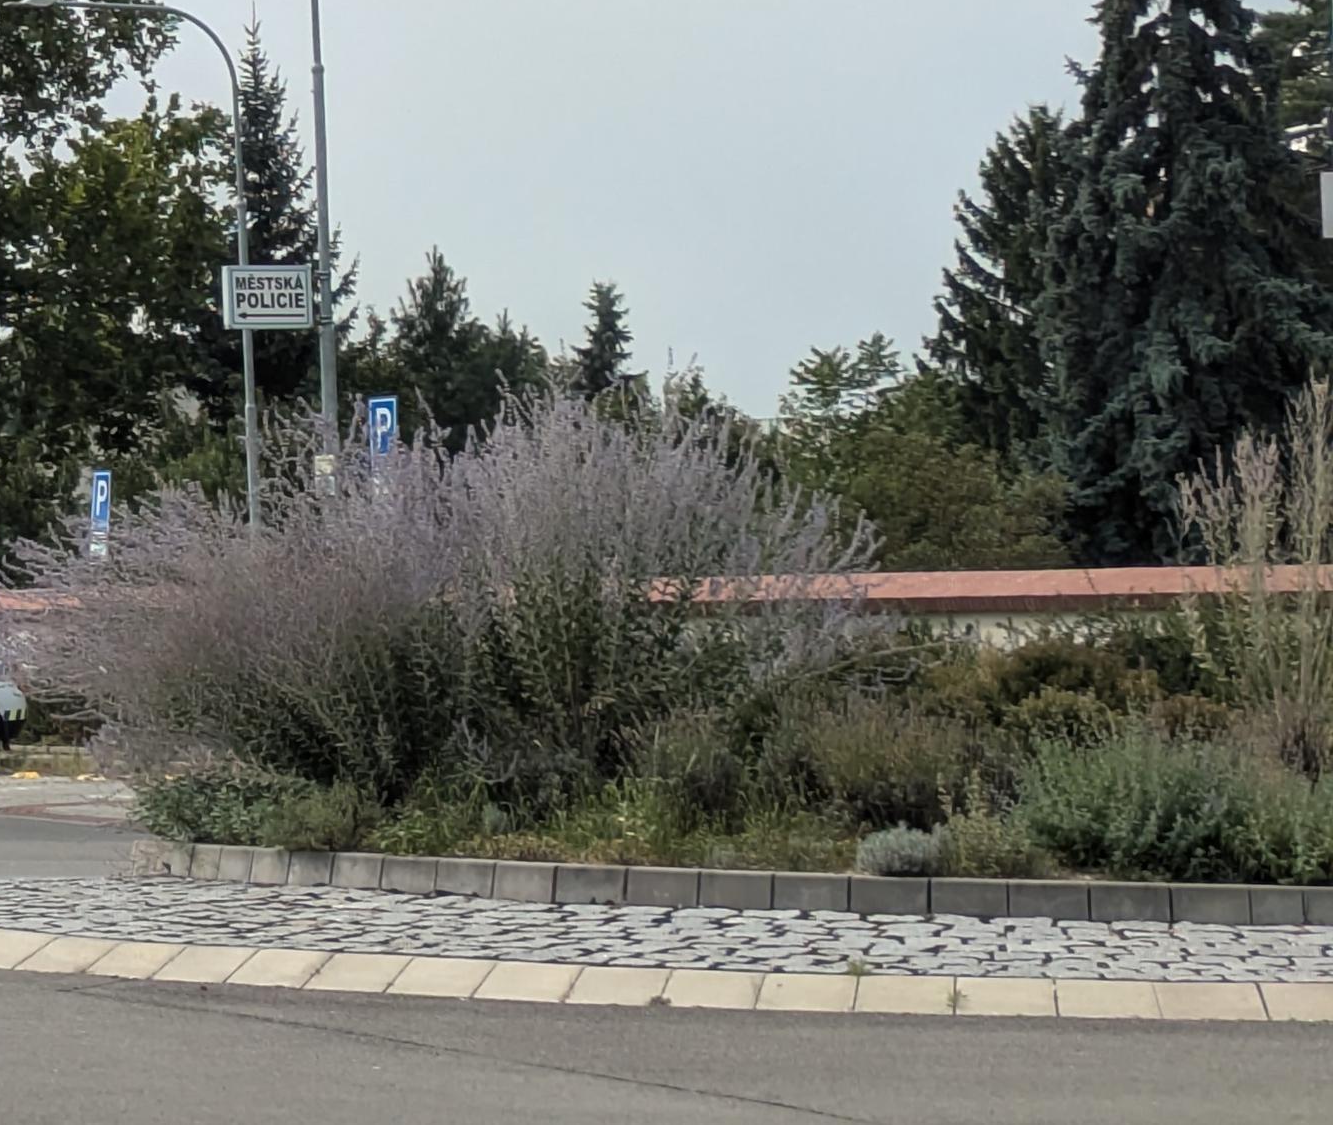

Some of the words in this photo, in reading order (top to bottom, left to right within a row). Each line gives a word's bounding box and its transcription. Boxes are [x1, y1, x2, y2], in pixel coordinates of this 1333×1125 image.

[235, 273, 303, 290] MĚSTSKÁ
[236, 292, 305, 309] POLICIE
[376, 407, 392, 449] P
[96, 479, 108, 516] P
